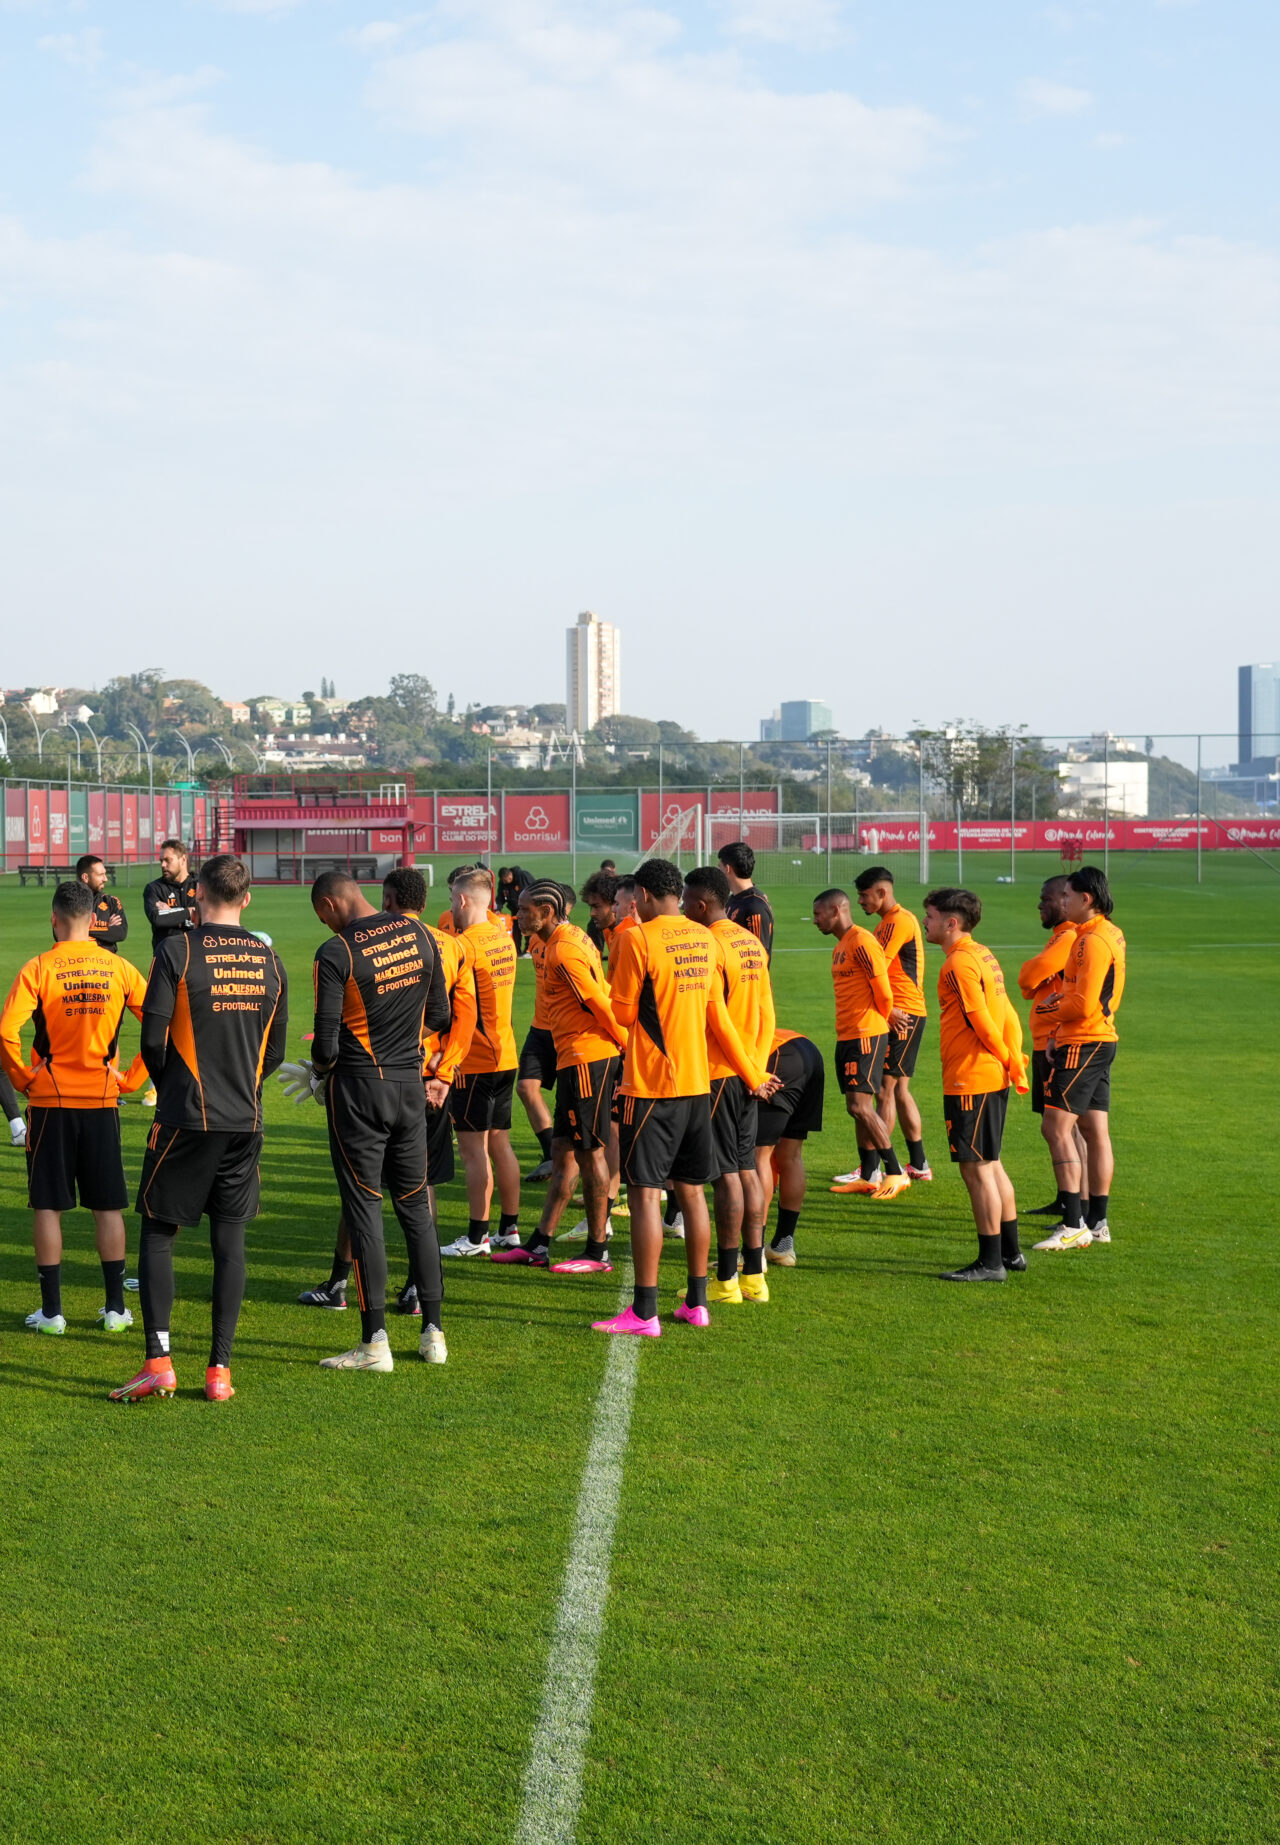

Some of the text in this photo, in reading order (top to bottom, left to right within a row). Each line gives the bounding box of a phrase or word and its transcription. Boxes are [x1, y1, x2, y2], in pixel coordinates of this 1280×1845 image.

[441, 805, 497, 816] ESTRELA
[462, 816, 486, 826] BET
[514, 831, 561, 841] banrisul
[367, 919, 411, 937] banrisul
[218, 935, 265, 949] banrisul
[68, 957, 113, 965] banrisul
[372, 944, 418, 968] Unimed
[491, 955, 513, 967] Unimed
[675, 954, 708, 965] Unimed
[213, 967, 264, 980] Unimed
[374, 959, 423, 983] MARQUESPAN
[63, 980, 109, 991] Unimed
[211, 983, 265, 996] MARQUESPAN
[62, 992, 111, 1004] MARQUESPAN
